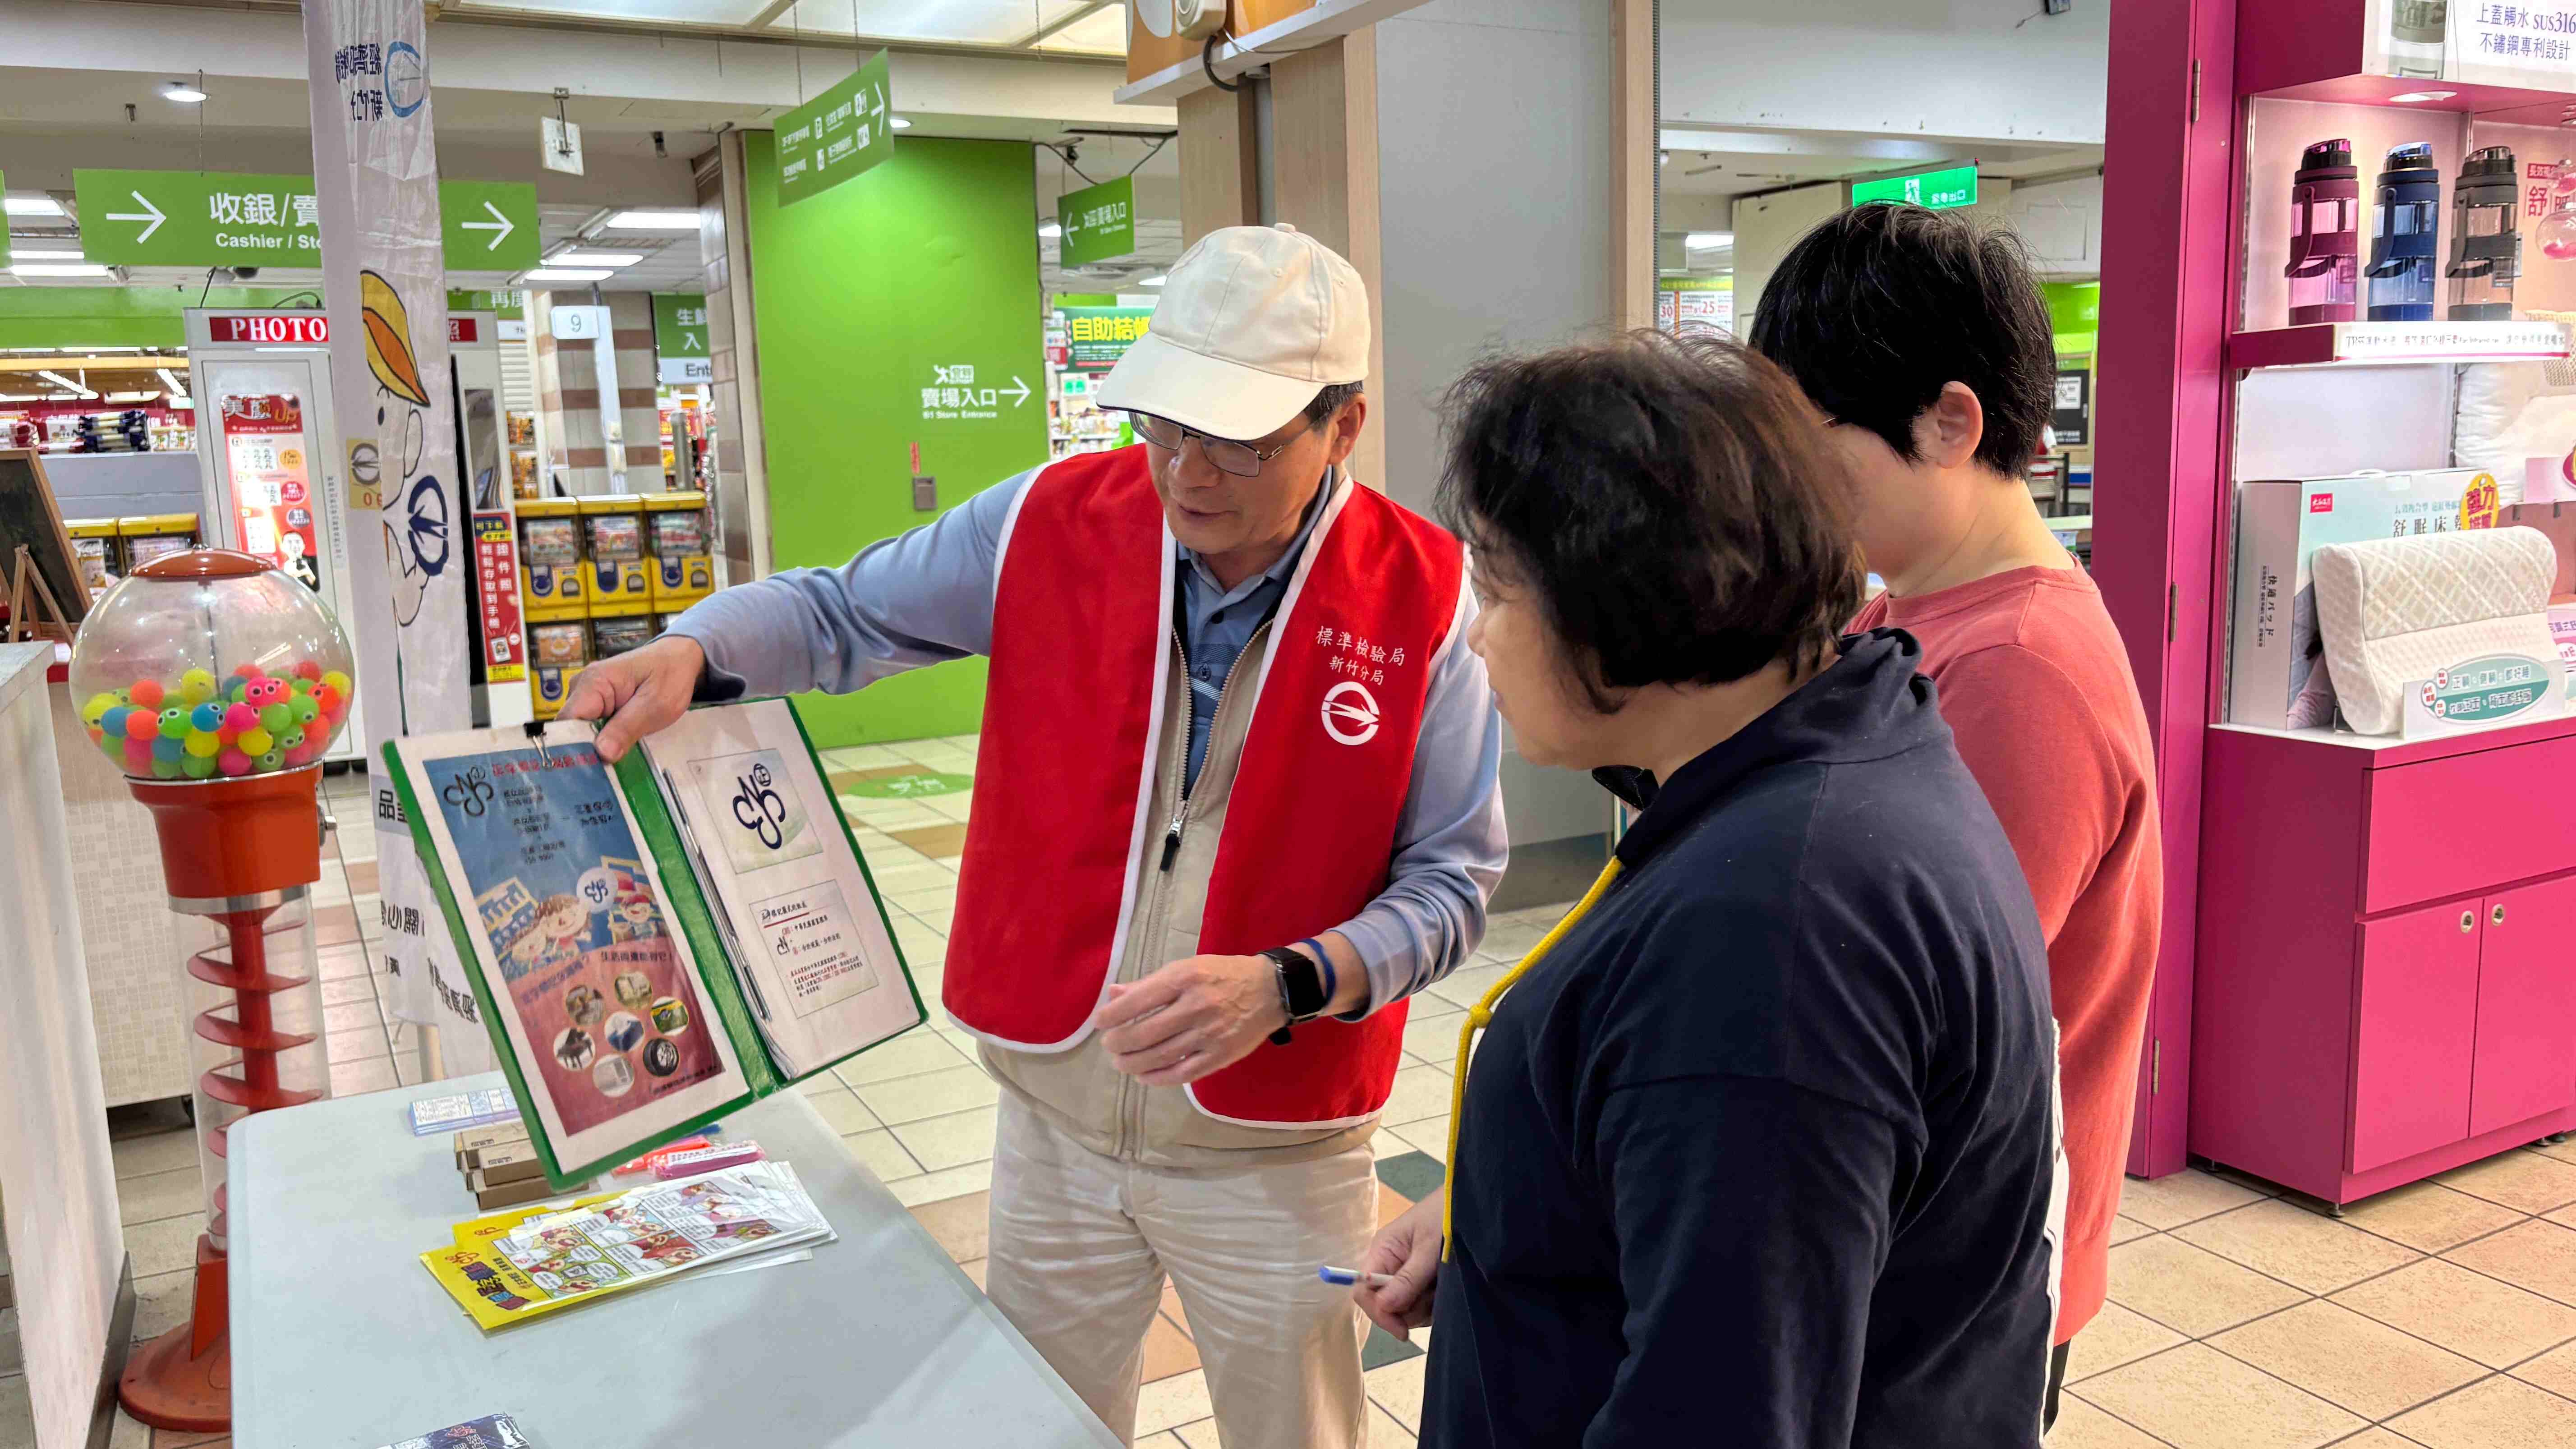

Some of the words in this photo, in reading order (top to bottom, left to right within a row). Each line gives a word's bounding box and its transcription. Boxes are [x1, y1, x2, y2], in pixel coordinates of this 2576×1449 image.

[216, 233, 283, 248] Cashier
[230, 317, 326, 342] PHOTO
[571, 314, 581, 332] 9
[921, 387, 997, 408] 賣場入口
[1316, 626, 1405, 666] 標準檢驗局
[1329, 655, 1384, 685] 新竹分局
